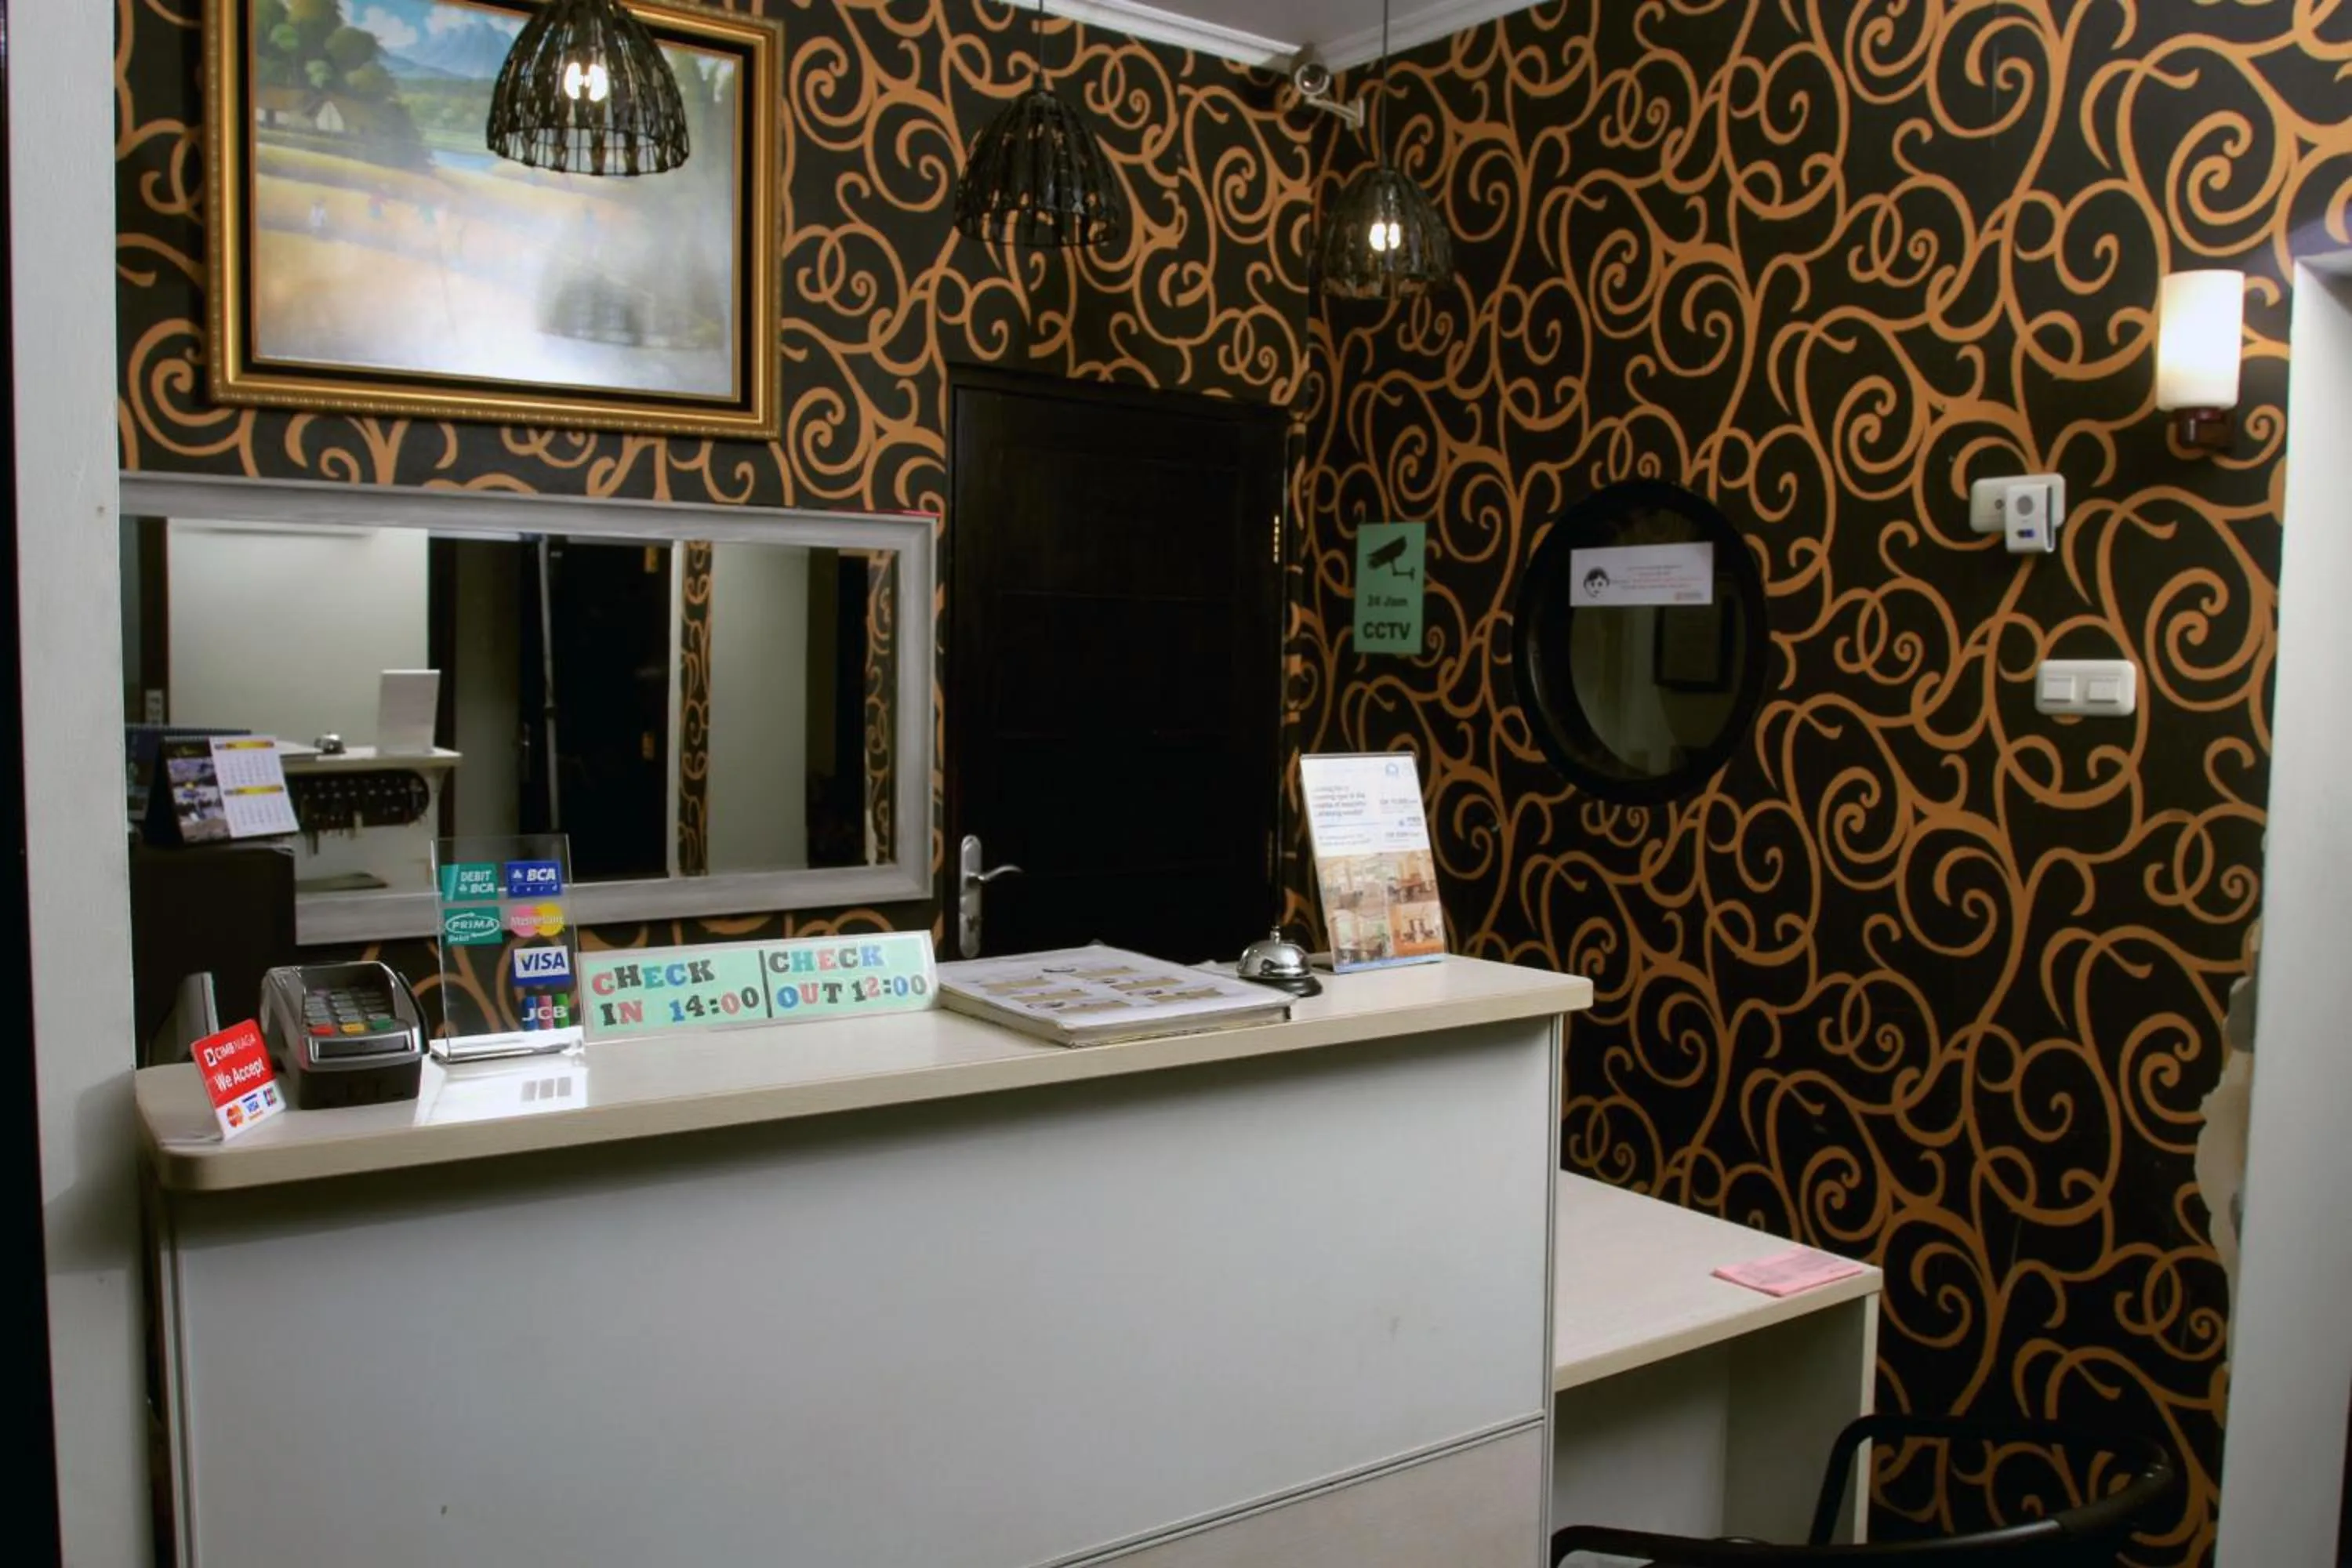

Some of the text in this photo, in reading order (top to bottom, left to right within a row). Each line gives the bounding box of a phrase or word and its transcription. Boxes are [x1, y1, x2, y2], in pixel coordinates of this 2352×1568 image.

[1363, 621, 1411, 640] CCTV
[460, 870, 492, 882] DEBIT
[526, 868, 557, 882] BCA
[470, 883, 495, 893] BCA
[452, 920, 495, 930] PRIMA
[520, 952, 565, 971] VISA
[768, 945, 885, 973] CHECK
[592, 959, 715, 996] CHECK
[777, 975, 927, 1009] OUT 12:00
[521, 1005, 568, 1021] JCB
[601, 986, 759, 1026] IN 14:00
[213, 1058, 264, 1091] We Accept
